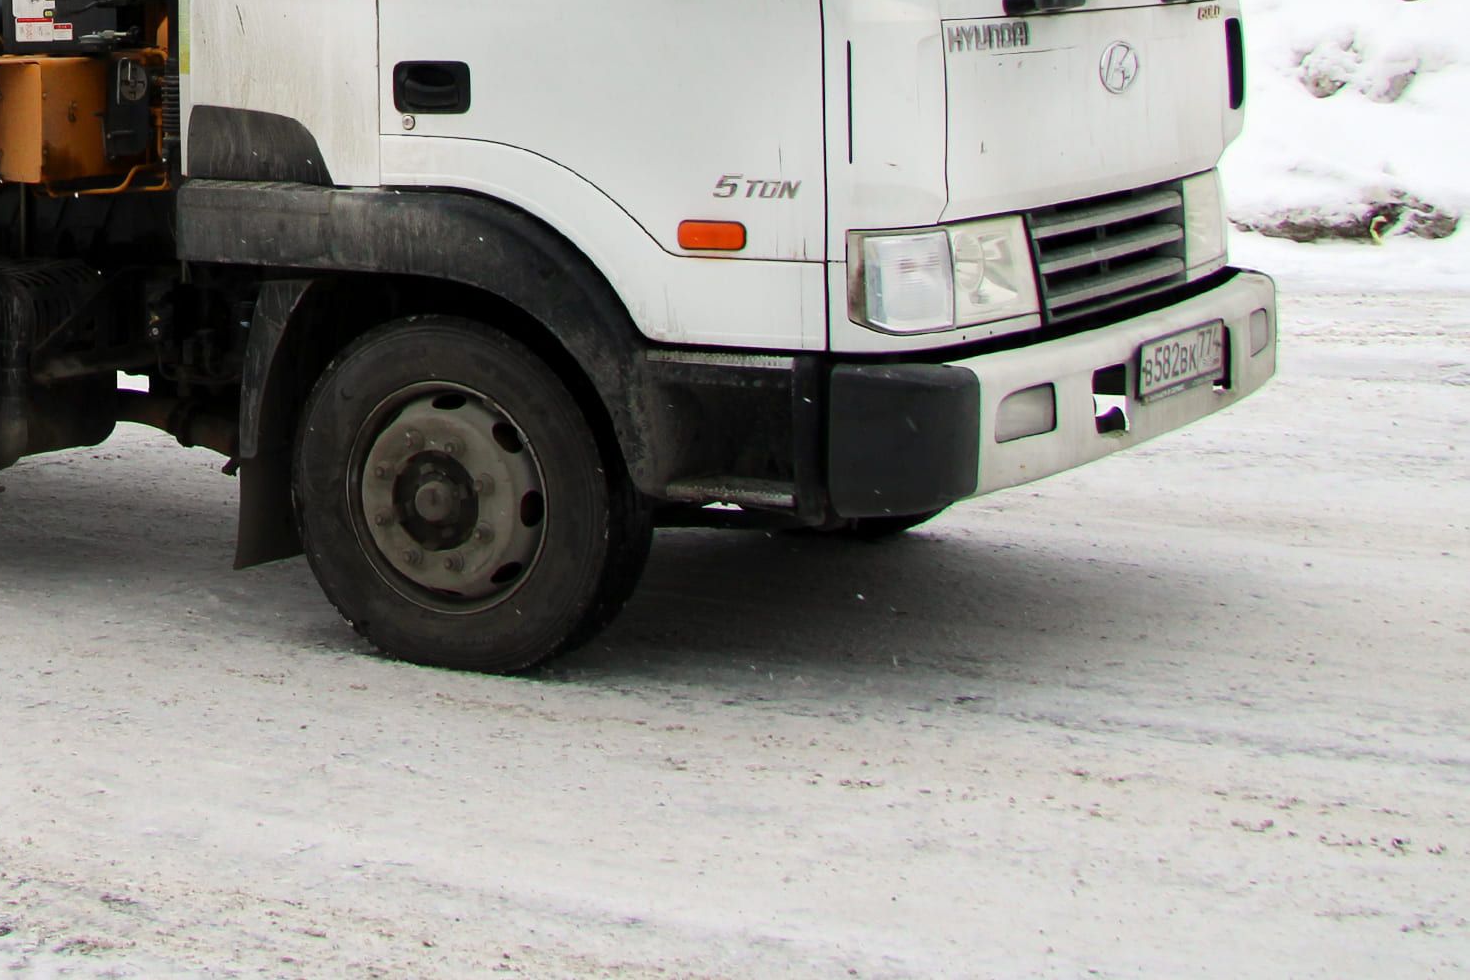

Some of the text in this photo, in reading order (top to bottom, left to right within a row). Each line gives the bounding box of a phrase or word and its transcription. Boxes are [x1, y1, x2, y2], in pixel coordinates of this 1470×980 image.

[947, 21, 1029, 53] HYUNDAI
[713, 173, 801, 199] 5 TON
